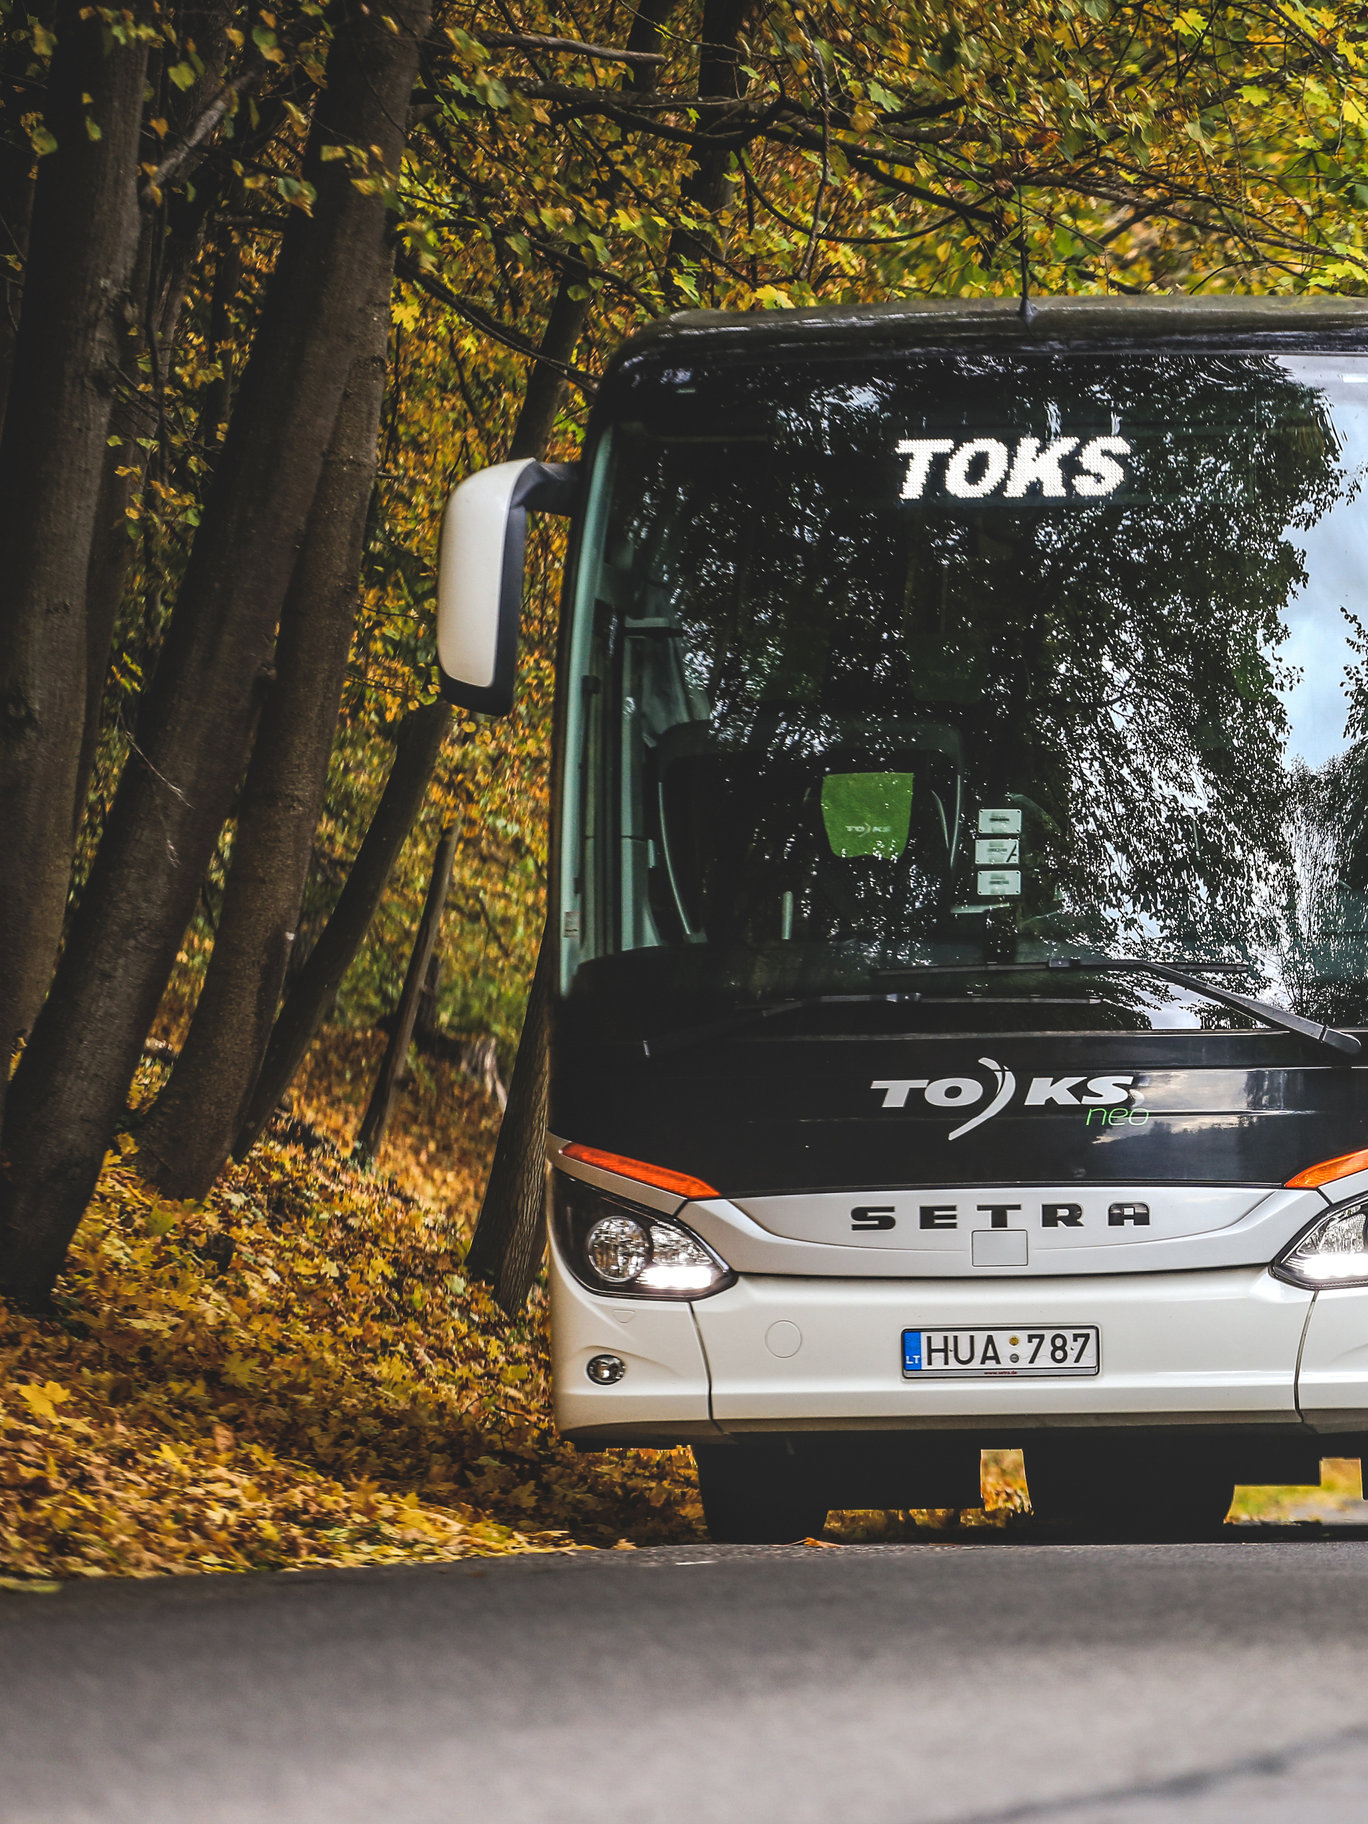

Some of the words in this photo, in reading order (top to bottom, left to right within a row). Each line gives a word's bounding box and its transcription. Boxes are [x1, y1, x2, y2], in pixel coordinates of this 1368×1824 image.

[895, 436, 1131, 499] TOKS
[1085, 1107, 1150, 1126] neo
[850, 1202, 1150, 1230] SETRA
[905, 1355, 921, 1365] LT
[926, 1334, 1002, 1366] HUA
[1027, 1333, 1091, 1364] 787
